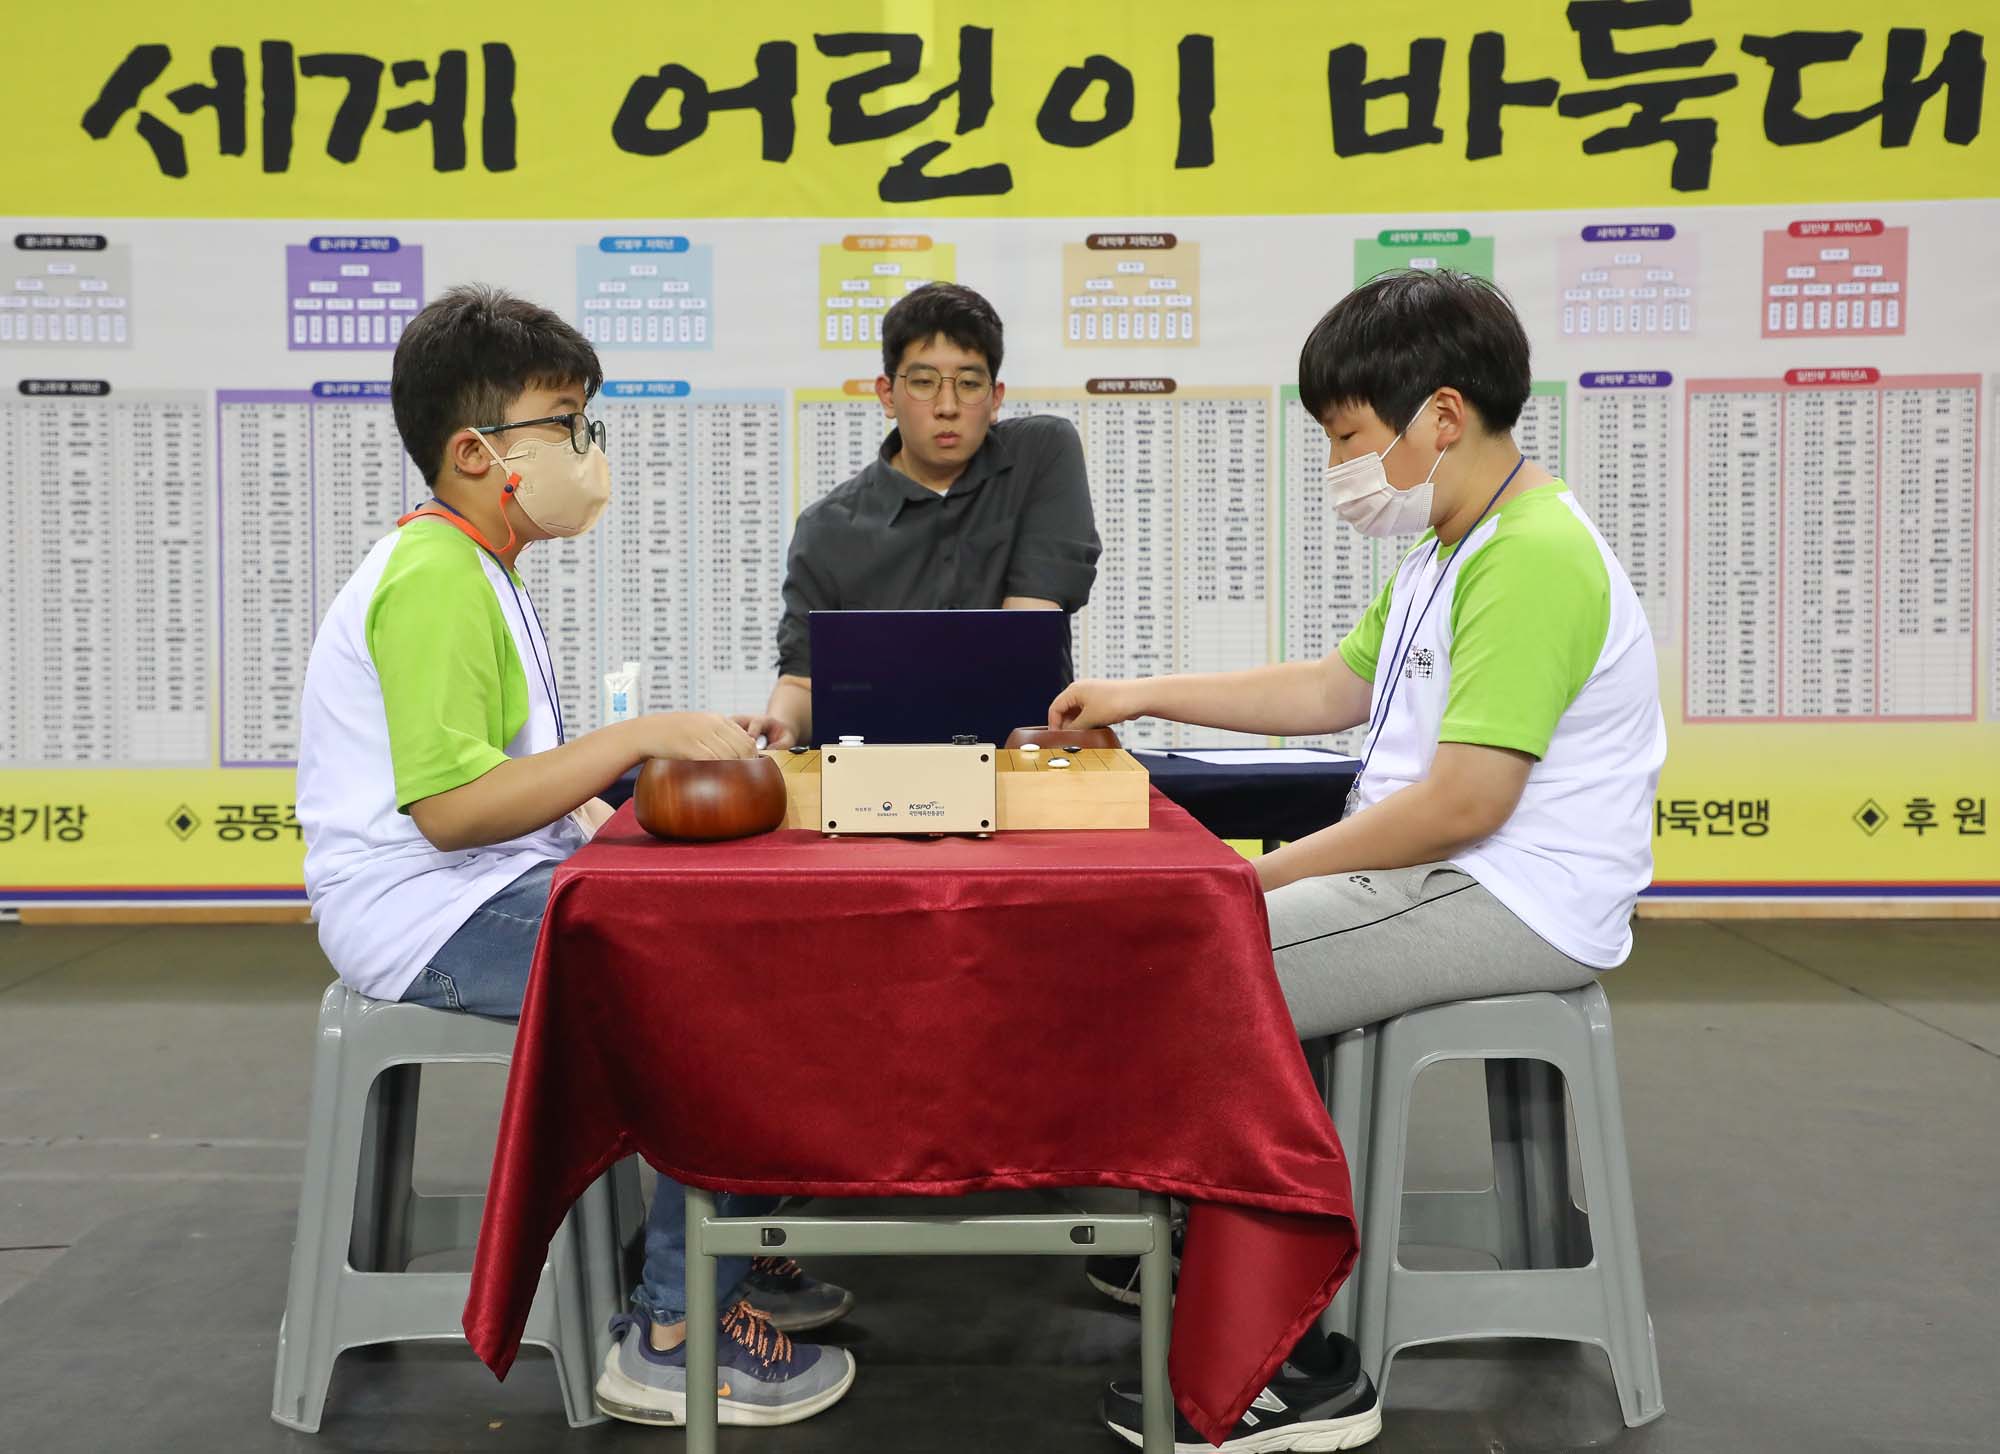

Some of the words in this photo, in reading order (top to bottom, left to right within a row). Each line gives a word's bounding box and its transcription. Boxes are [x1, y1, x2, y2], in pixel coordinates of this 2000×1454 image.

[81, 40, 517, 178] 세계
[612, 25, 1215, 203] 어린이
[1328, 0, 1986, 192] 바둑대
